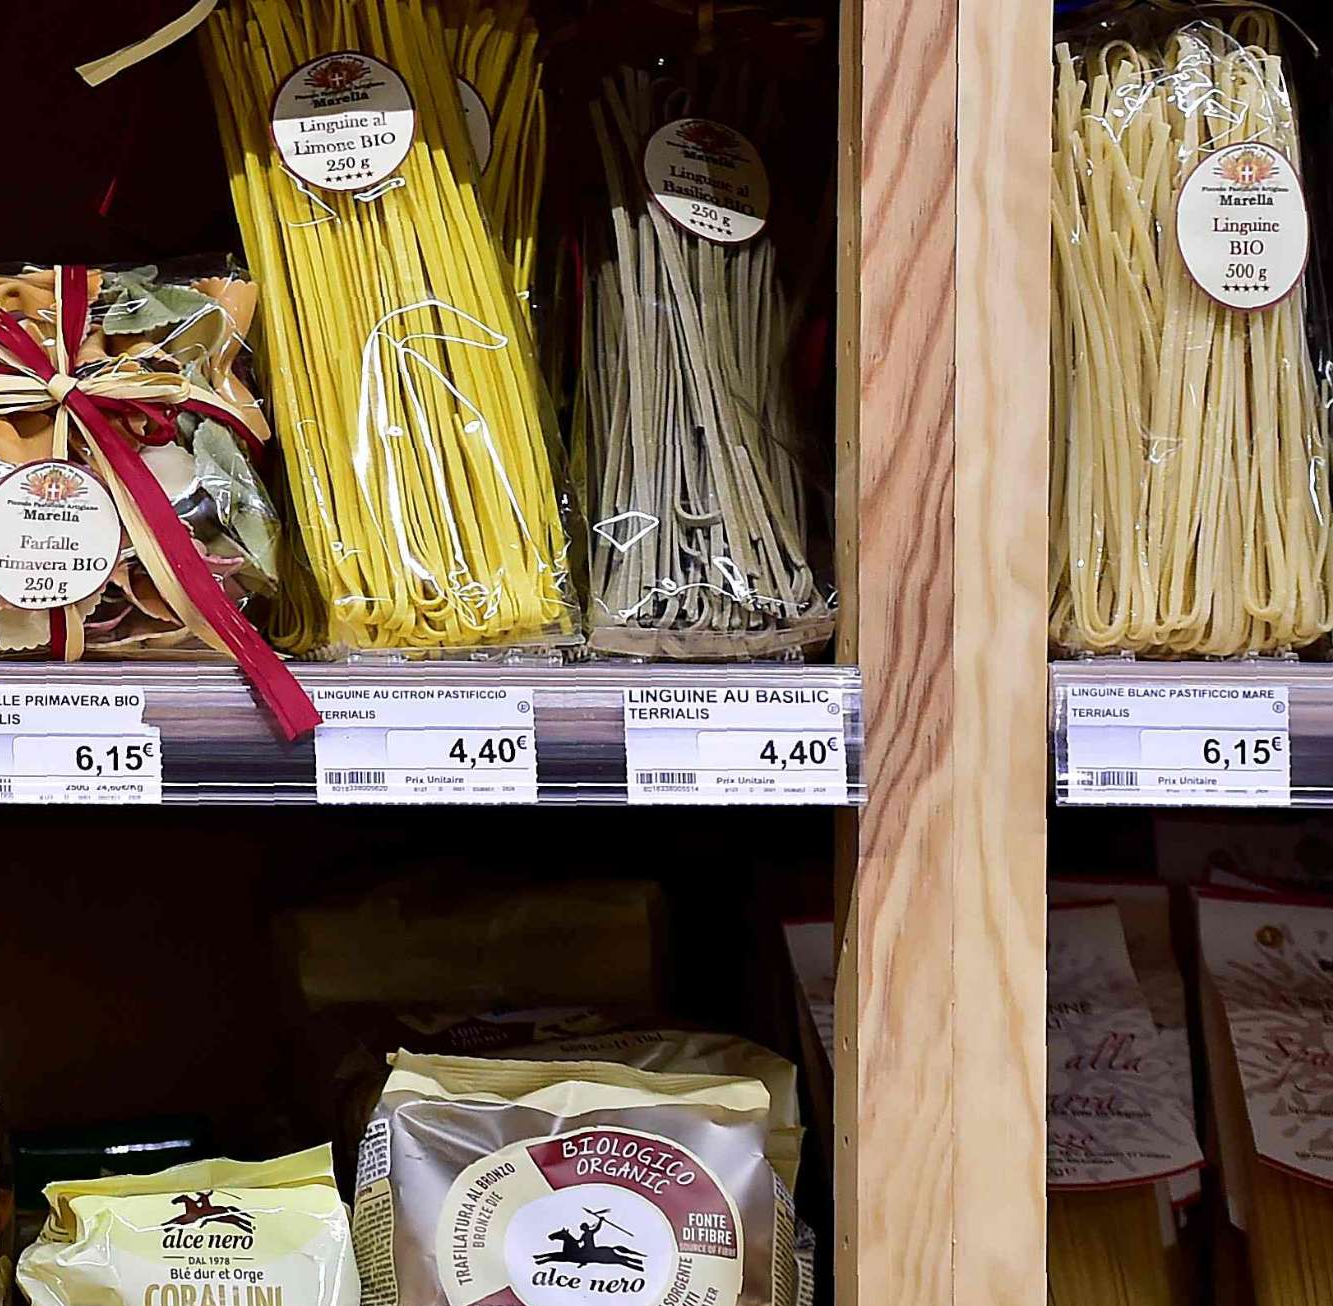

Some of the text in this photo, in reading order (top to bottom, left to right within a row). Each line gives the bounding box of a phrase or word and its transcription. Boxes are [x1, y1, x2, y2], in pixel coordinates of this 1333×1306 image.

[300, 112, 387, 135] Linguine al
[293, 133, 396, 157] Limone BIO
[1219, 194, 1273, 206] Marella
[1213, 218, 1279, 235] Linguine
[1230, 240, 1264, 256] BIO
[24, 509, 80, 523] Marella
[20, 535, 79, 551] Farfalle
[73, 559, 107, 571] BIO
[25, 578, 54, 591] 250
[25, 694, 109, 707] PRIMAVERA
[115, 695, 139, 706] BIO
[317, 690, 506, 699] LINGUINE CITRON PASTIFICCIO
[629, 690, 829, 704] LINGUINE BASILIC
[1071, 688, 1274, 699] LINGUINE BLANC PASTIFICCIO MARE
[629, 708, 709, 720] TERRIALIS
[562, 1137, 696, 1187] BIOLOGICO
[576, 1158, 671, 1195] ORGANIC
[688, 1213, 727, 1228] FONTE
[162, 1229, 253, 1250] alce nero
[682, 1227, 732, 1245] DI FIBRE
[188, 1256, 230, 1265] DAL 1978
[170, 1268, 264, 1283] Blé dur et Orge
[532, 1268, 646, 1295] alce nero
